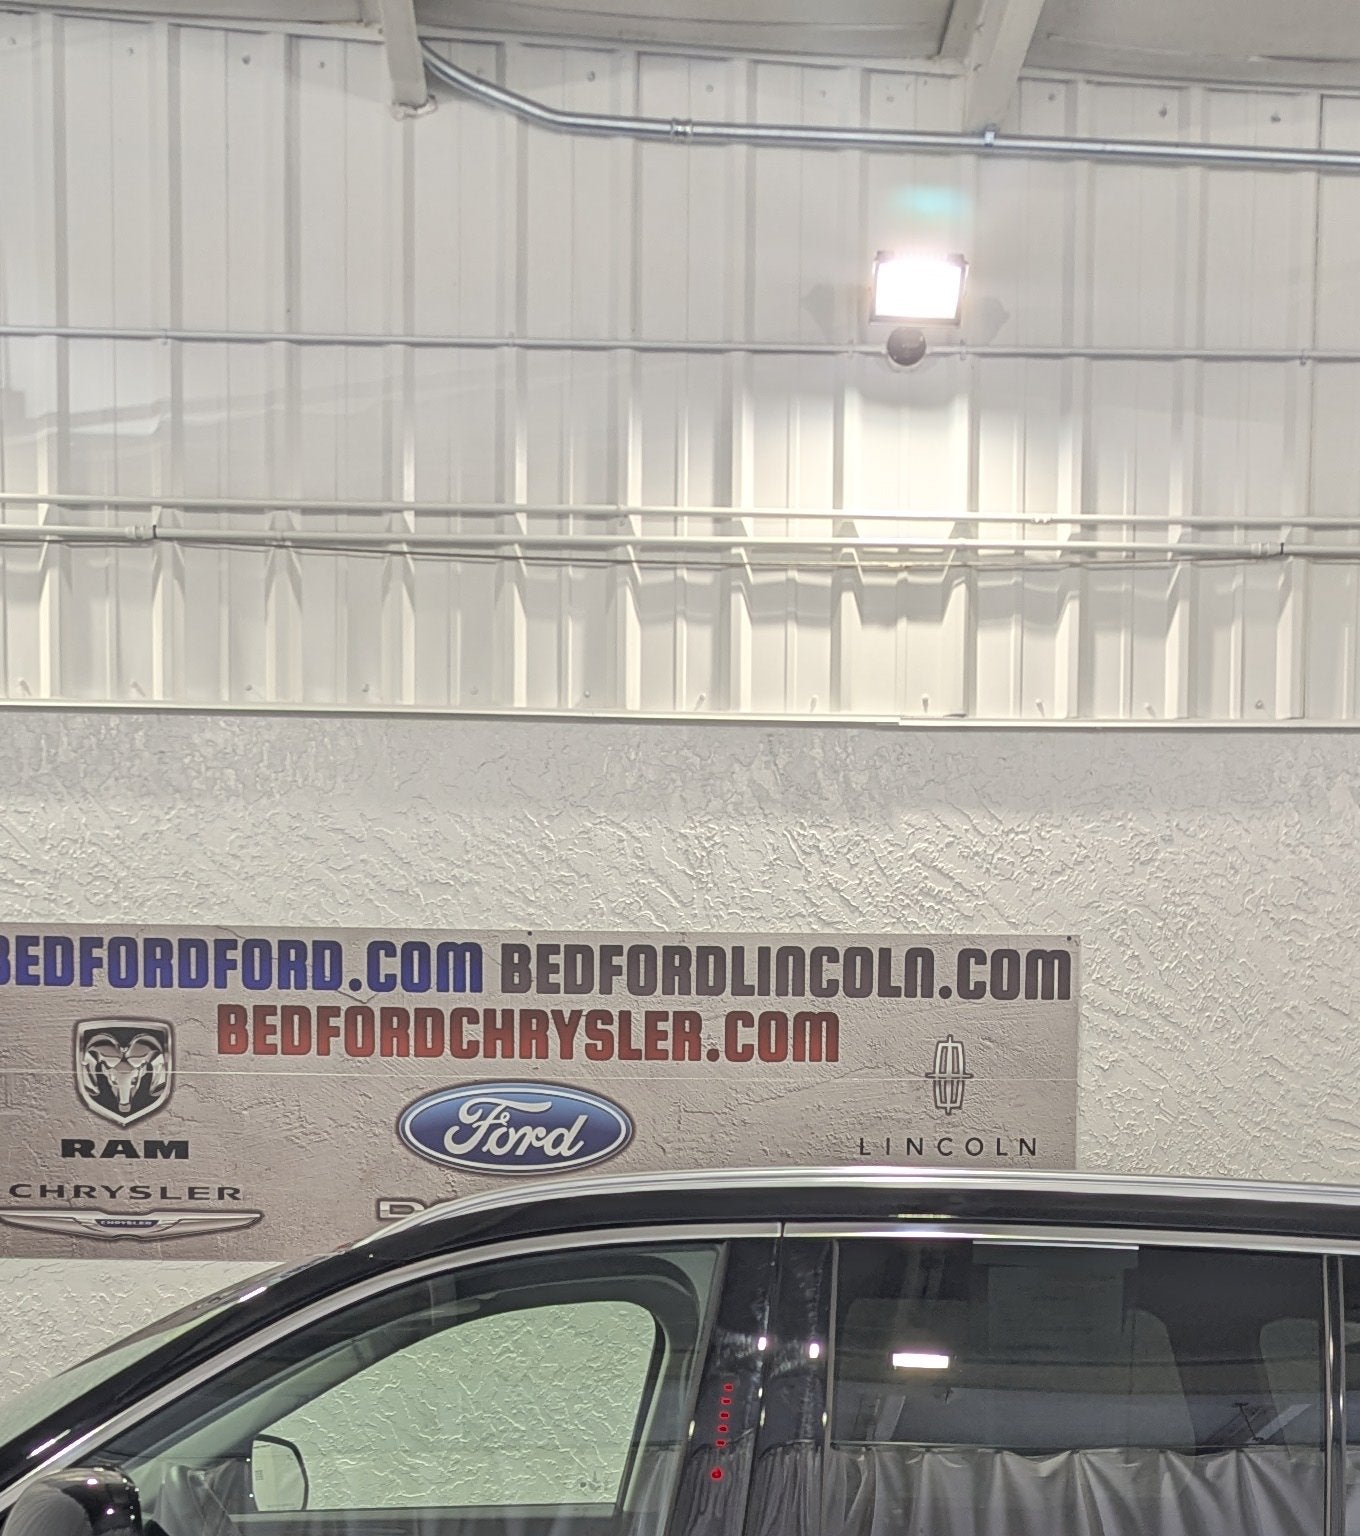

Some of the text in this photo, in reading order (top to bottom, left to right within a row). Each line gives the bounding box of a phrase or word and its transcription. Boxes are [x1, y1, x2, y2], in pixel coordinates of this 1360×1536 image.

[500, 943, 1071, 1001] BEDFORDLINCOLN.COM
[217, 1004, 840, 1063] BEDFORDCHRYSLER.COM
[443, 1097, 589, 1157] Ford
[859, 1137, 1037, 1157] LINCOLN
[60, 1138, 190, 1160] RAM
[8, 1183, 242, 1201] CHRYSLER
